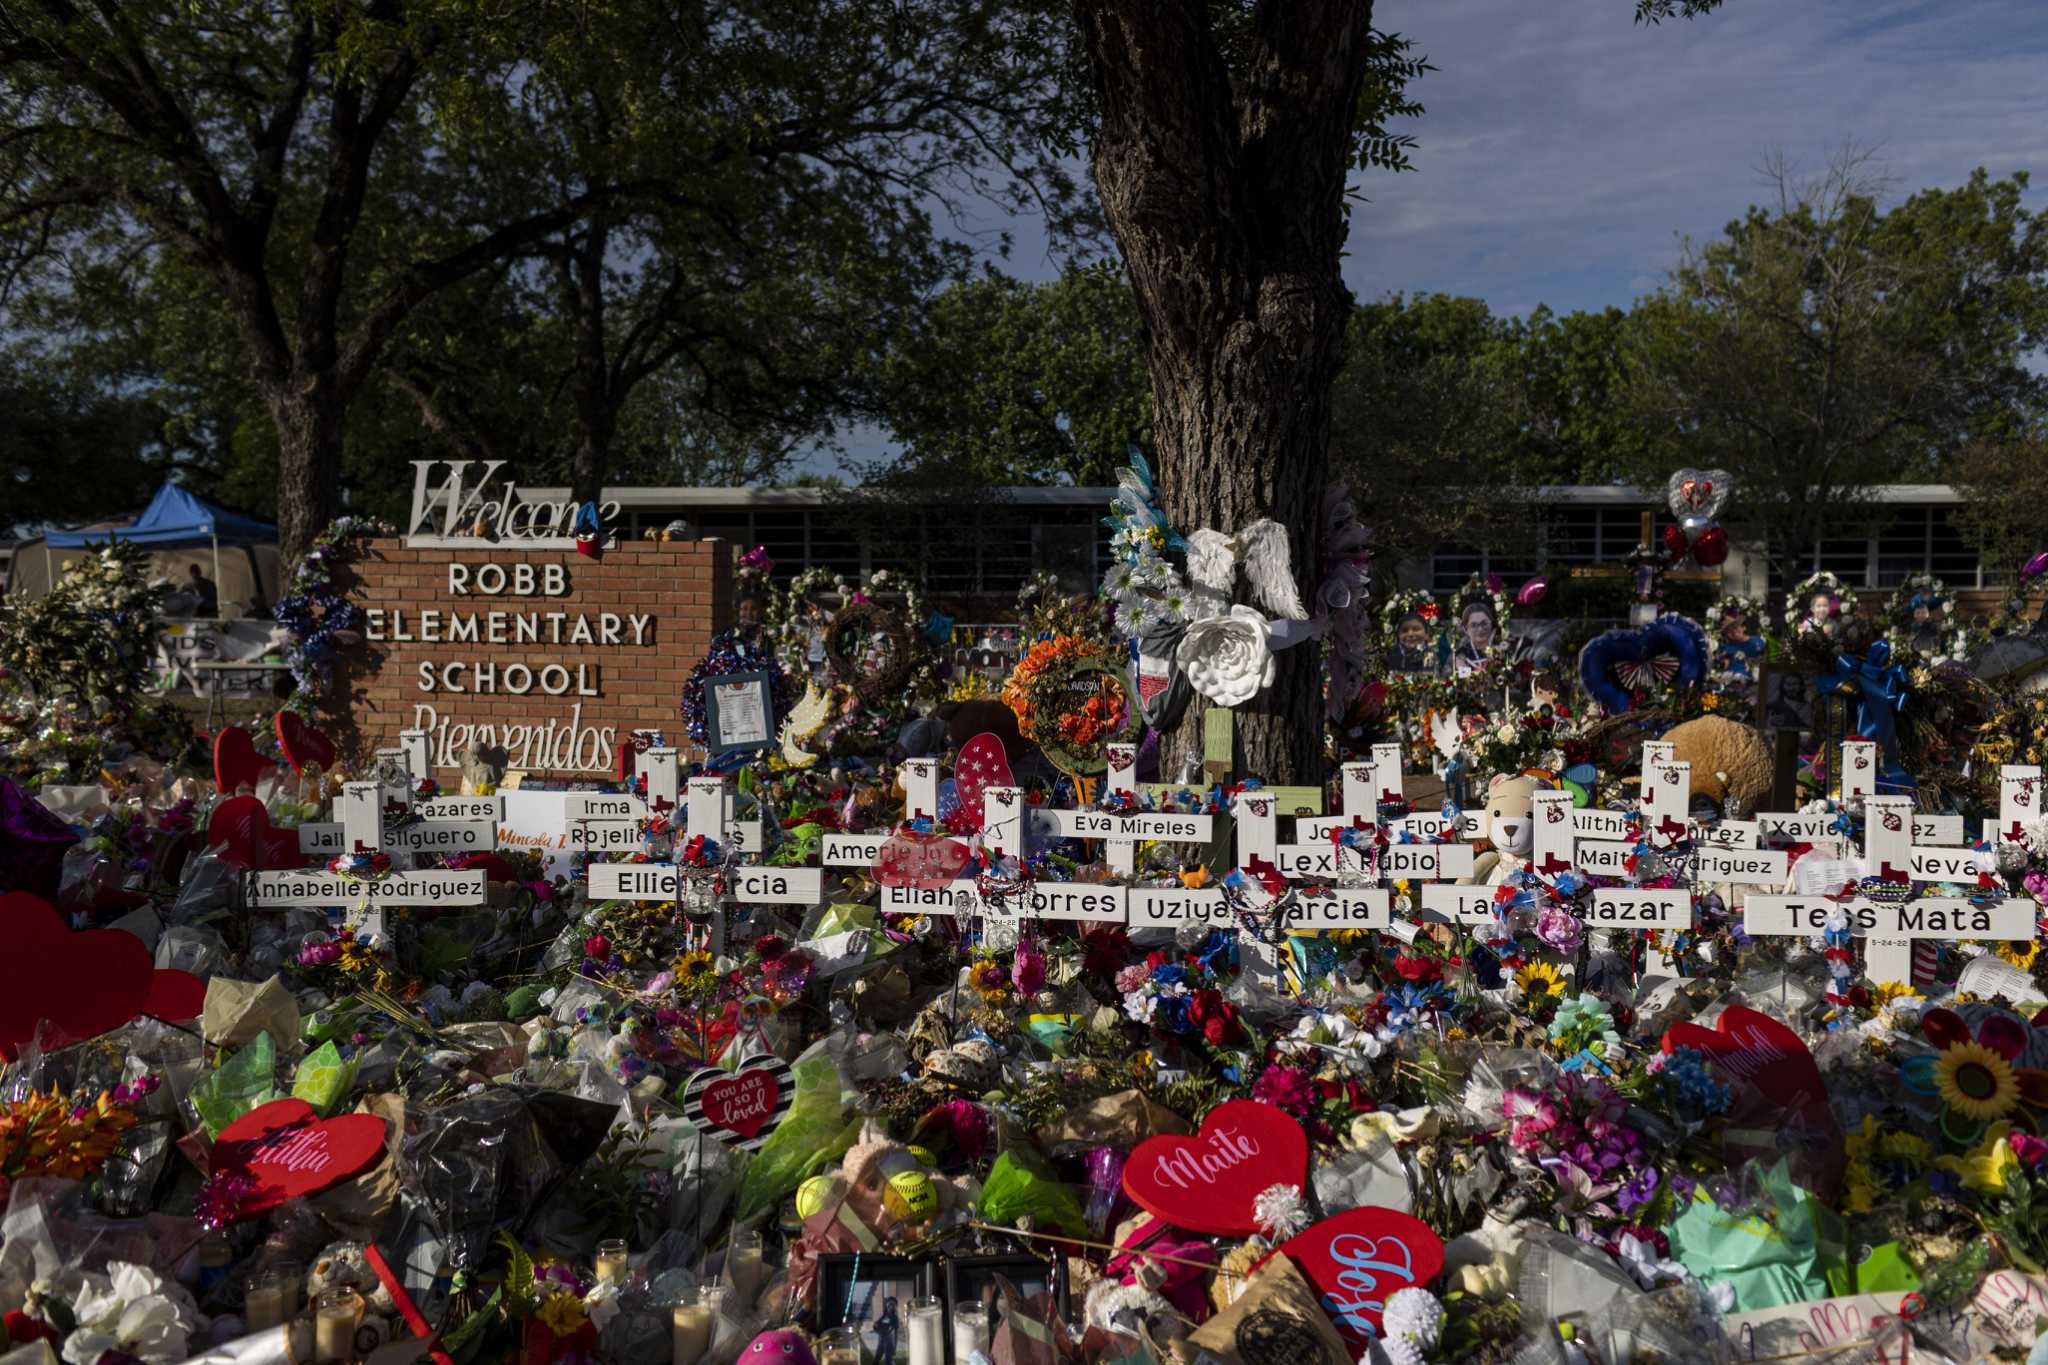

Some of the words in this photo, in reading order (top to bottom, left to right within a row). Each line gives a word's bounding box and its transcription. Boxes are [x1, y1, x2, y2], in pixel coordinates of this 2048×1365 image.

[408, 459, 621, 540] Welcome
[448, 563, 566, 596] ROBB
[366, 608, 650, 646] ELEMENTARY
[418, 660, 601, 697] SCHOOL
[413, 703, 616, 771] Bienvenidos
[412, 802, 493, 817] Cazares
[584, 799, 631, 815] Irma
[1075, 816, 1112, 831] Eva
[1120, 818, 1196, 836] Mireles
[1405, 816, 1479, 836] Flors
[1772, 819, 1838, 837] Xavie
[309, 831, 345, 847] Jail
[383, 830, 476, 850] Silguero
[826, 843, 911, 860] Amerie
[1280, 854, 1336, 872] Lex
[1361, 852, 1435, 872] Rubio
[1580, 849, 1628, 867] Mait
[247, 881, 360, 898] Annabelle
[369, 881, 483, 900] Rodriguez
[617, 872, 677, 893] Ellie
[1018, 890, 1116, 913] Torres
[1147, 897, 1230, 923] Uziya
[1287, 898, 1369, 920] arcia
[1572, 898, 1674, 920] alazar
[1898, 907, 1991, 931] Mata
[1871, 938, 1909, 947] 5-24-22
[713, 1084, 737, 1101] YOU
[740, 1076, 762, 1092] ARE
[720, 1089, 768, 1125] loved
[734, 1093, 752, 1106] SO
[1153, 1126, 1260, 1189] Maite
[1321, 1232, 1415, 1343] Jose
